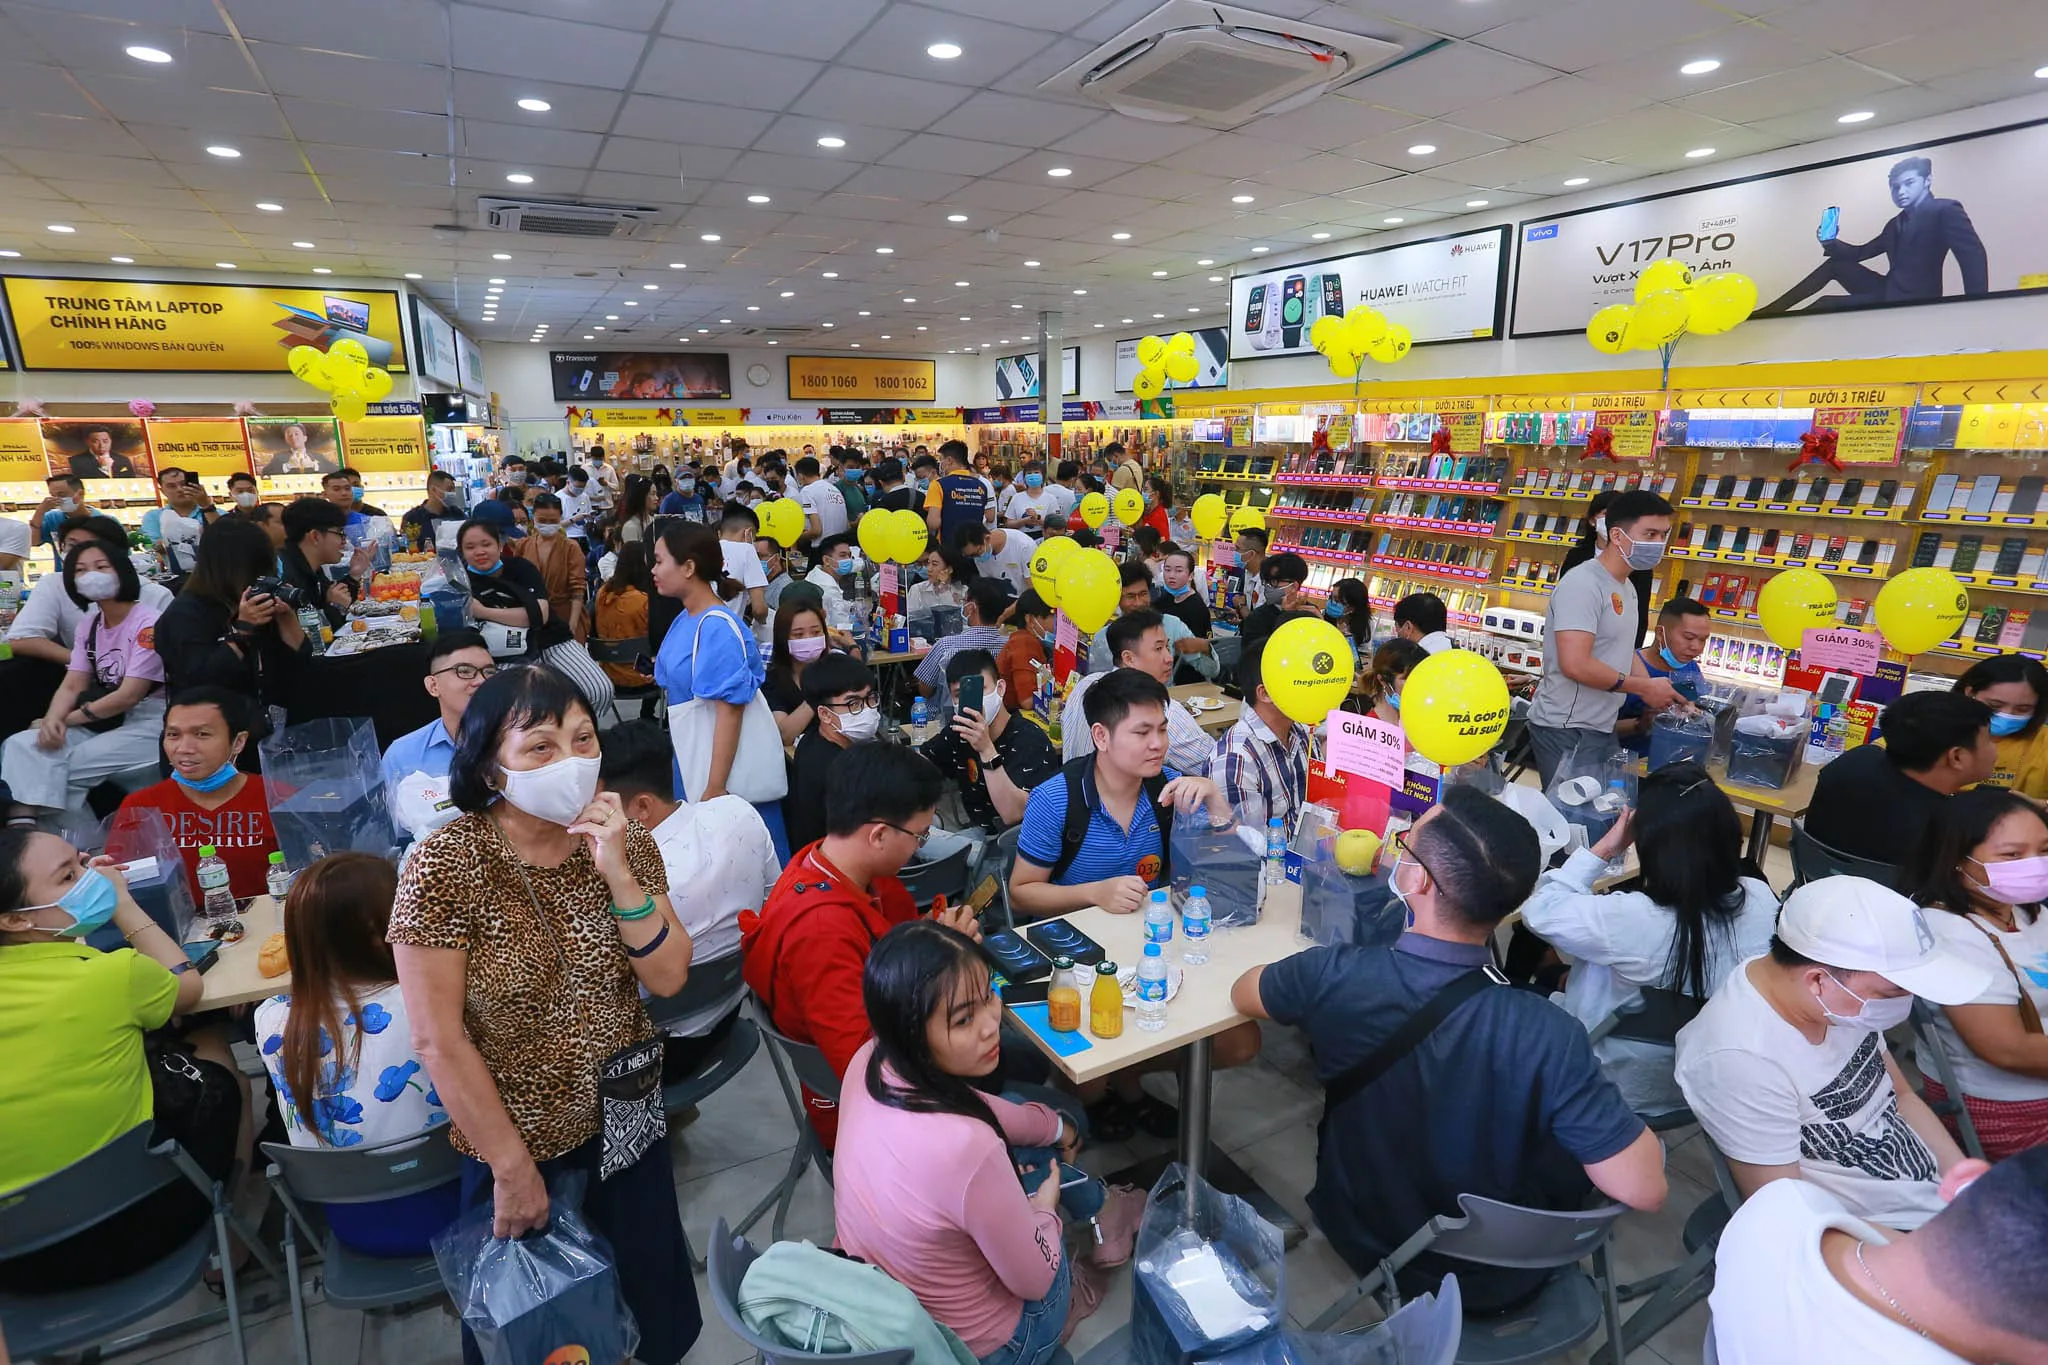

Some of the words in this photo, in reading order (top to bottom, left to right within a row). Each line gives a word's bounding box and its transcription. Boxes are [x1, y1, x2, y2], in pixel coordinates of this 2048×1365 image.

[1532, 229, 1553, 238] vivo
[1464, 242, 1496, 253] HUAWEI
[1360, 284, 1408, 302] HUAWEI
[1411, 278, 1450, 295] WATCH
[1452, 275, 1468, 290] FIT
[45, 296, 111, 311] TRUNG
[114, 297, 152, 313] TÂM
[156, 300, 223, 315] LAPTOP
[50, 313, 111, 329] CHÍNH
[115, 315, 167, 331] HÃNG
[70, 340, 100, 350] 100%
[102, 341, 160, 351] WINDOWS
[801, 375, 828, 388] 1800
[831, 375, 857, 388] 1060
[874, 376, 900, 389] 1800
[902, 377, 927, 390] 1062
[1841, 391, 1847, 403] 3
[1598, 413, 1627, 426] HOT
[1820, 411, 1860, 425] HOT
[1685, 439, 1706, 447] vivo
[1706, 440, 1727, 448] vivo
[1728, 440, 1749, 448] vivo
[1816, 633, 1848, 645] GIẢM
[1852, 634, 1874, 650] 30%
[1448, 711, 1471, 723] TRẢ
[1474, 710, 1497, 723] GÓP
[1342, 720, 1378, 741] GIẢM
[1380, 731, 1401, 751] 30%
[1459, 726, 1477, 736] LÃI
[161, 811, 264, 836] DESIRE
[1138, 863, 1160, 877] 032
